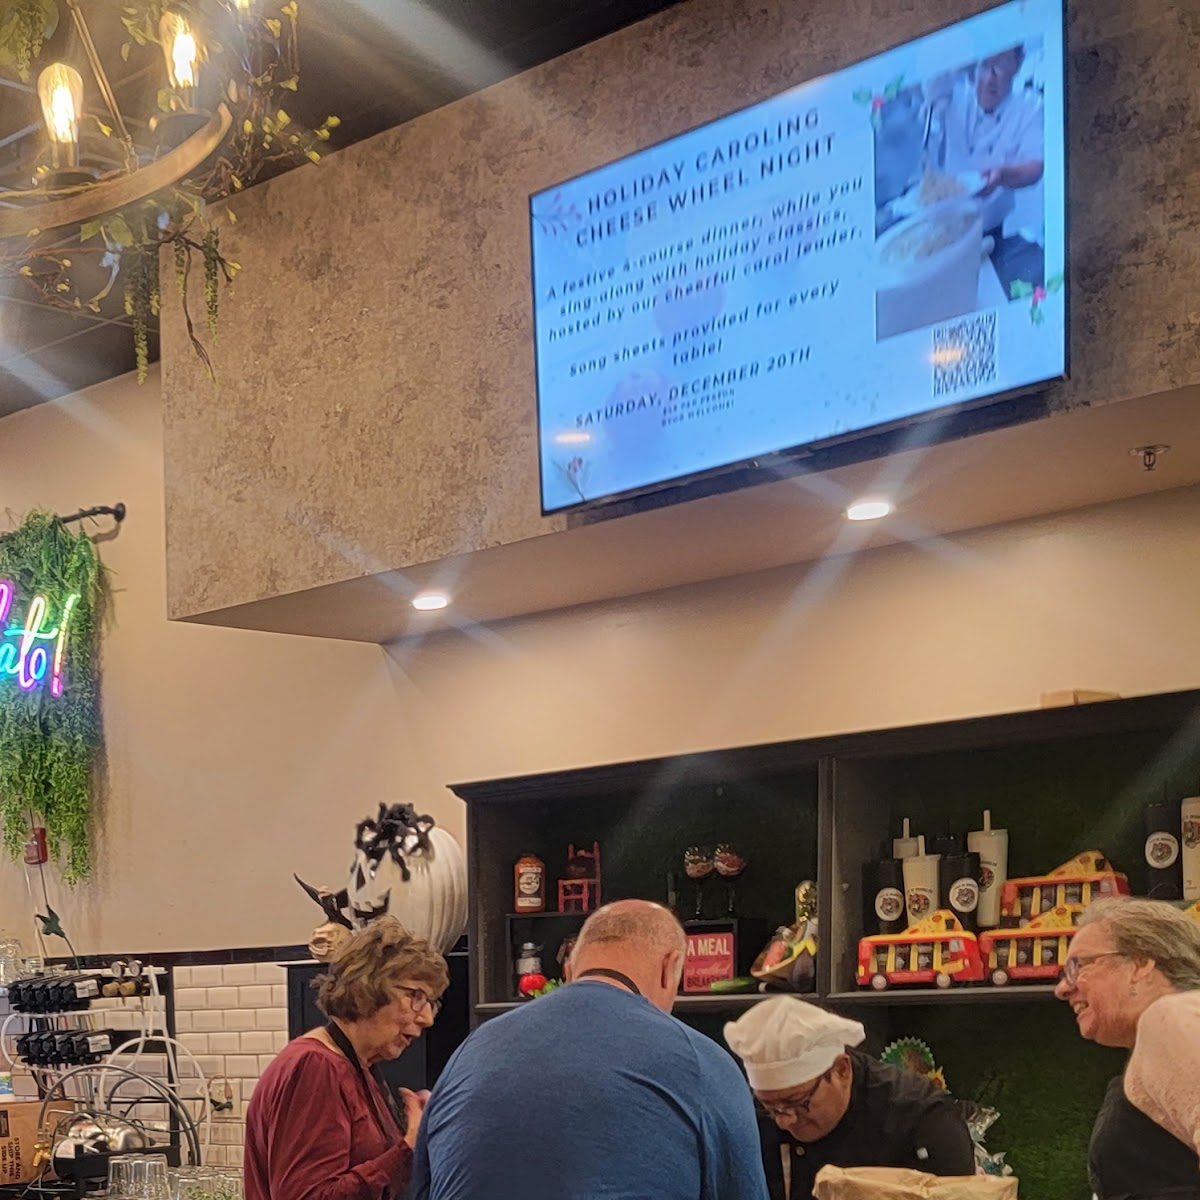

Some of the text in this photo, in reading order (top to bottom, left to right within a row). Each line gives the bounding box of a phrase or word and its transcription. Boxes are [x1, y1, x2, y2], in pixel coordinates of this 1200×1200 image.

[576, 132, 835, 247] CHEESE WHEEL NIGHT
[588, 107, 819, 215] HOLIDAY CAROLING
[548, 287, 557, 300] A
[563, 267, 615, 295] festive
[701, 215, 763, 245] dinner,
[772, 192, 820, 221] while
[830, 176, 863, 201] you
[549, 226, 862, 343] hosted by our cheerful carol leader.
[560, 278, 644, 317] sing-along
[651, 261, 688, 286] with
[695, 236, 760, 270] holiday
[570, 279, 840, 377] Song sheets provided for every
[576, 346, 811, 428] SATURDAY, DECEMBER 20TH
[687, 937, 731, 957] A MEAL
